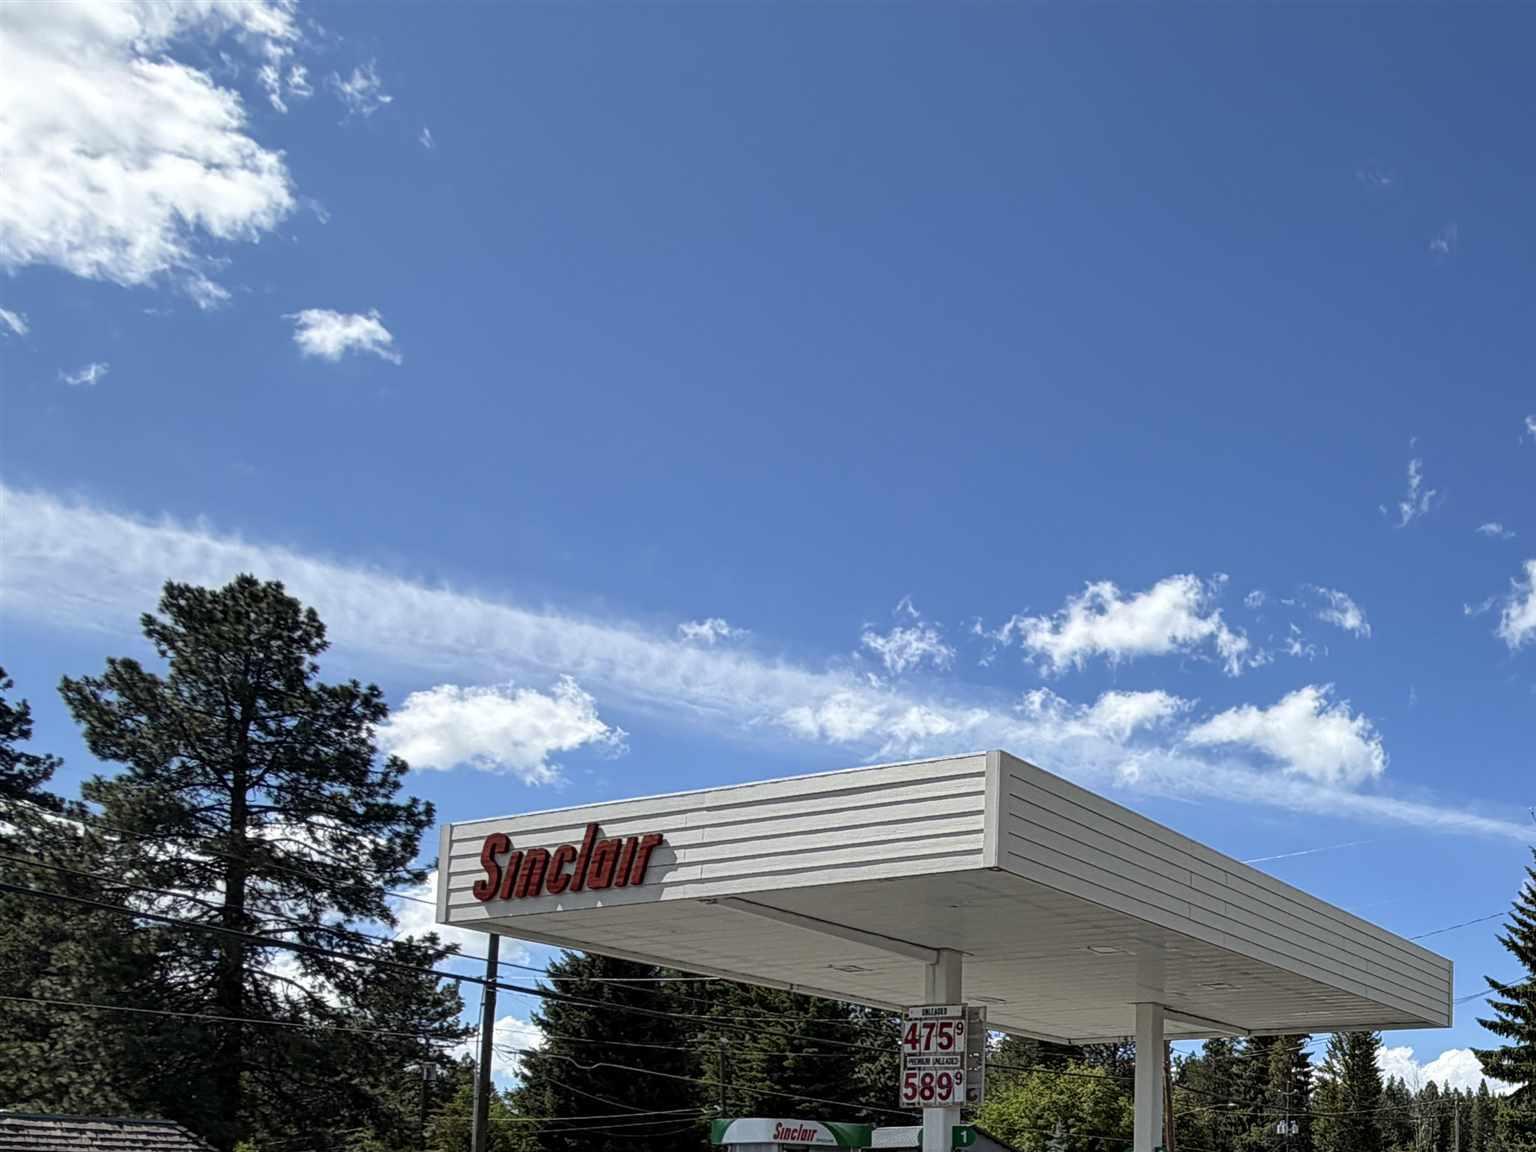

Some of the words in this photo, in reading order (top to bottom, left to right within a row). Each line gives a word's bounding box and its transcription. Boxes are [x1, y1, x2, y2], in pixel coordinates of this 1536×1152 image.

[472, 822, 663, 901] Sinclair
[773, 1121, 817, 1142] Sinclair
[960, 1130, 967, 1143] 1
